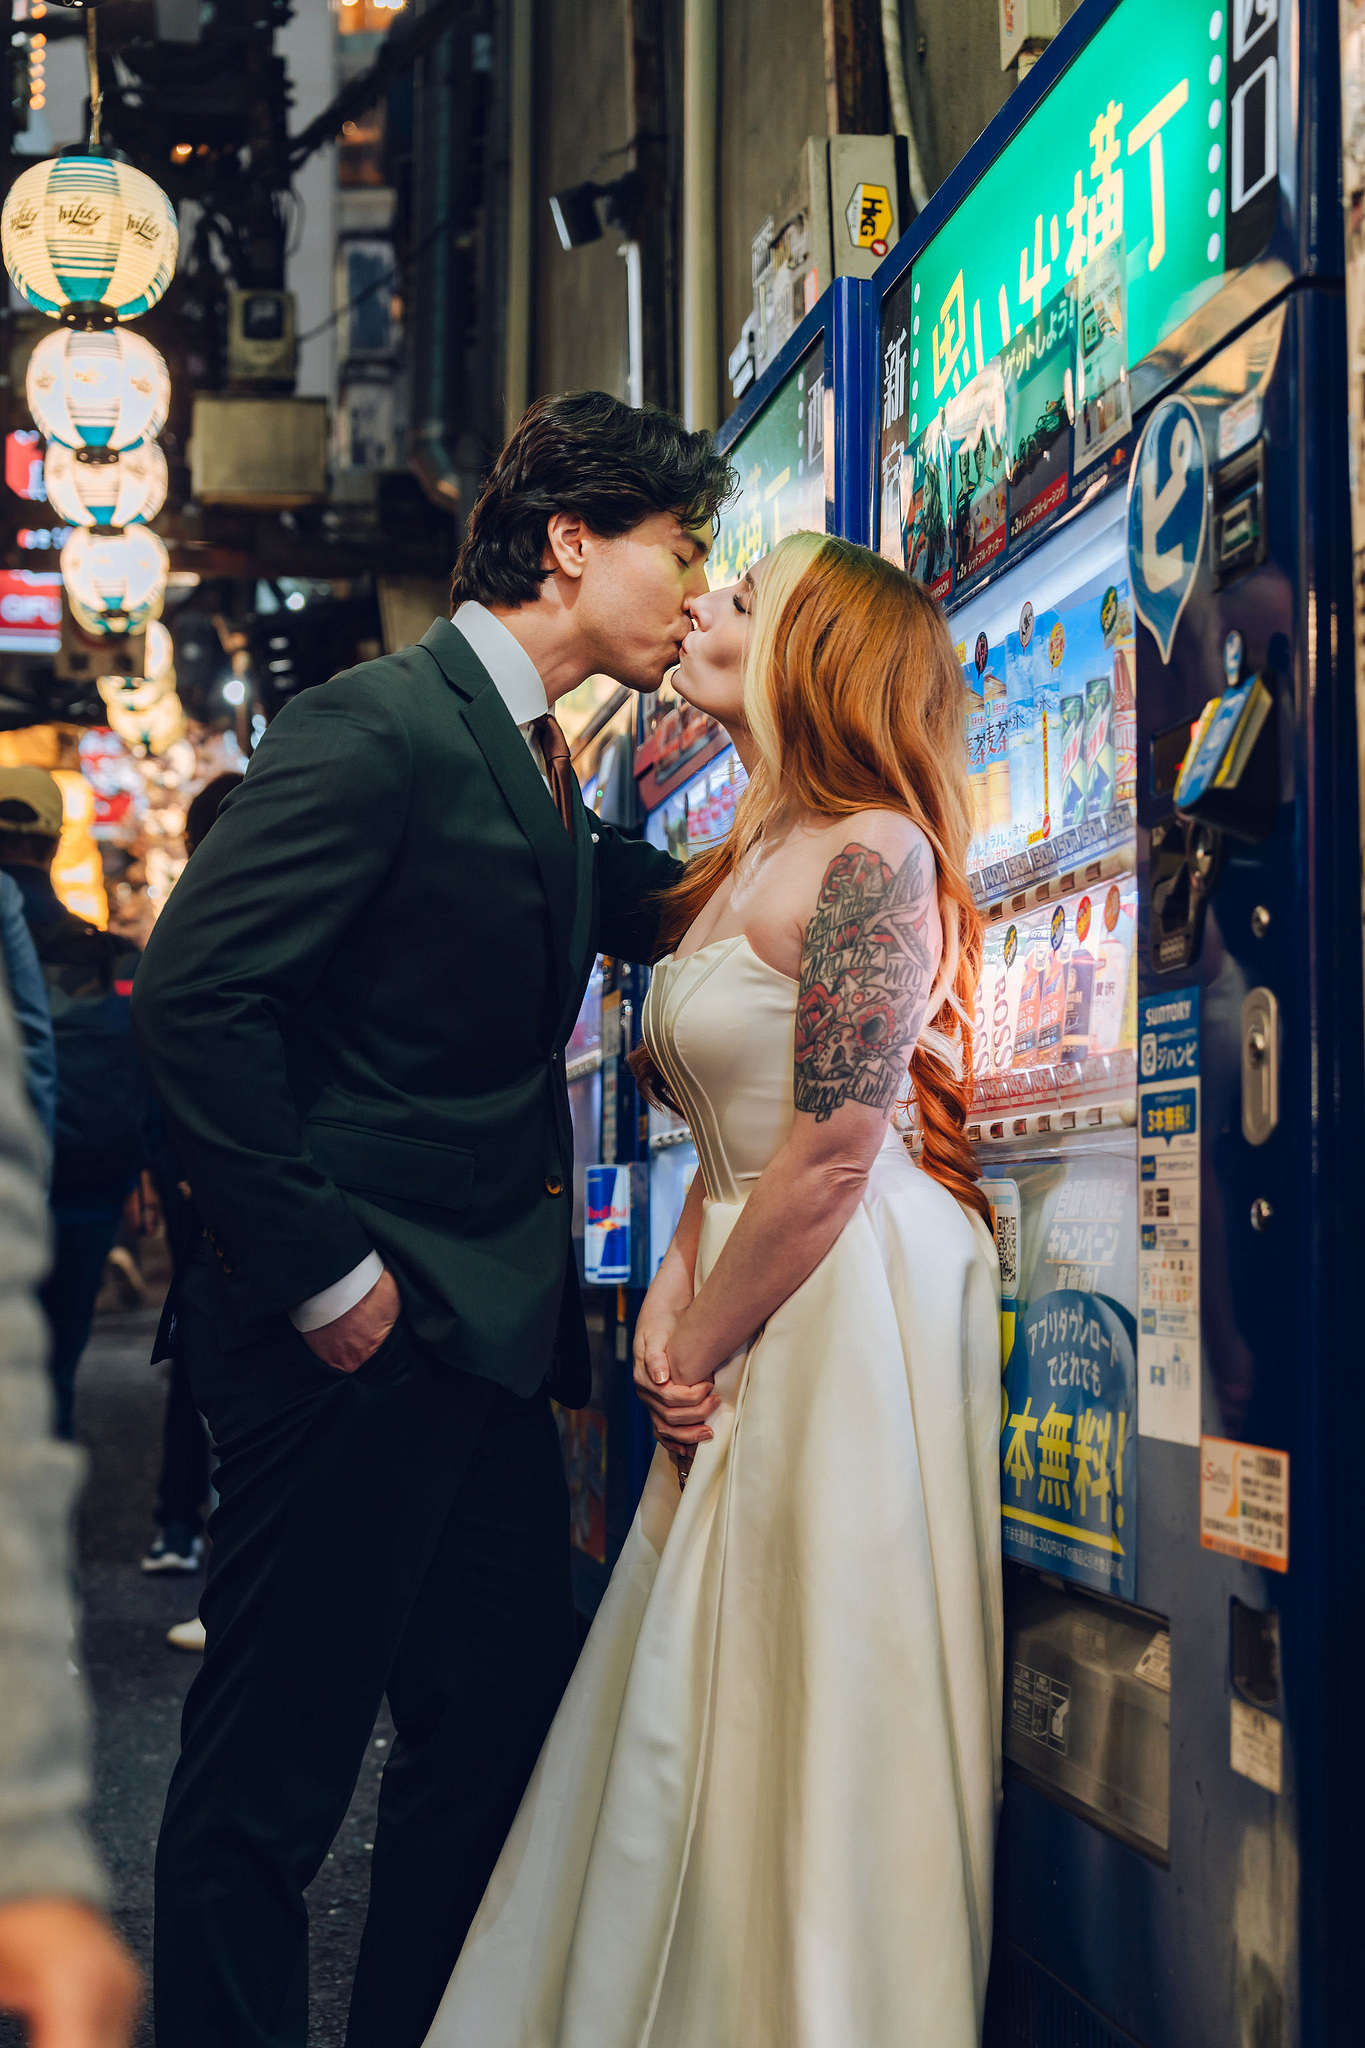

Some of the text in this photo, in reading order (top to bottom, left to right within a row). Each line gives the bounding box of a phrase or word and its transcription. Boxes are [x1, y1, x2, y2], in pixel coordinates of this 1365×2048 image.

[861, 197, 883, 237] HKG
[1145, 1001, 1191, 1026] SUNTORY
[1028, 1308, 1119, 1368] アプリダウンロード
[1047, 1352, 1101, 1397] でどれでも
[1003, 1397, 1126, 1529] 本無料!
